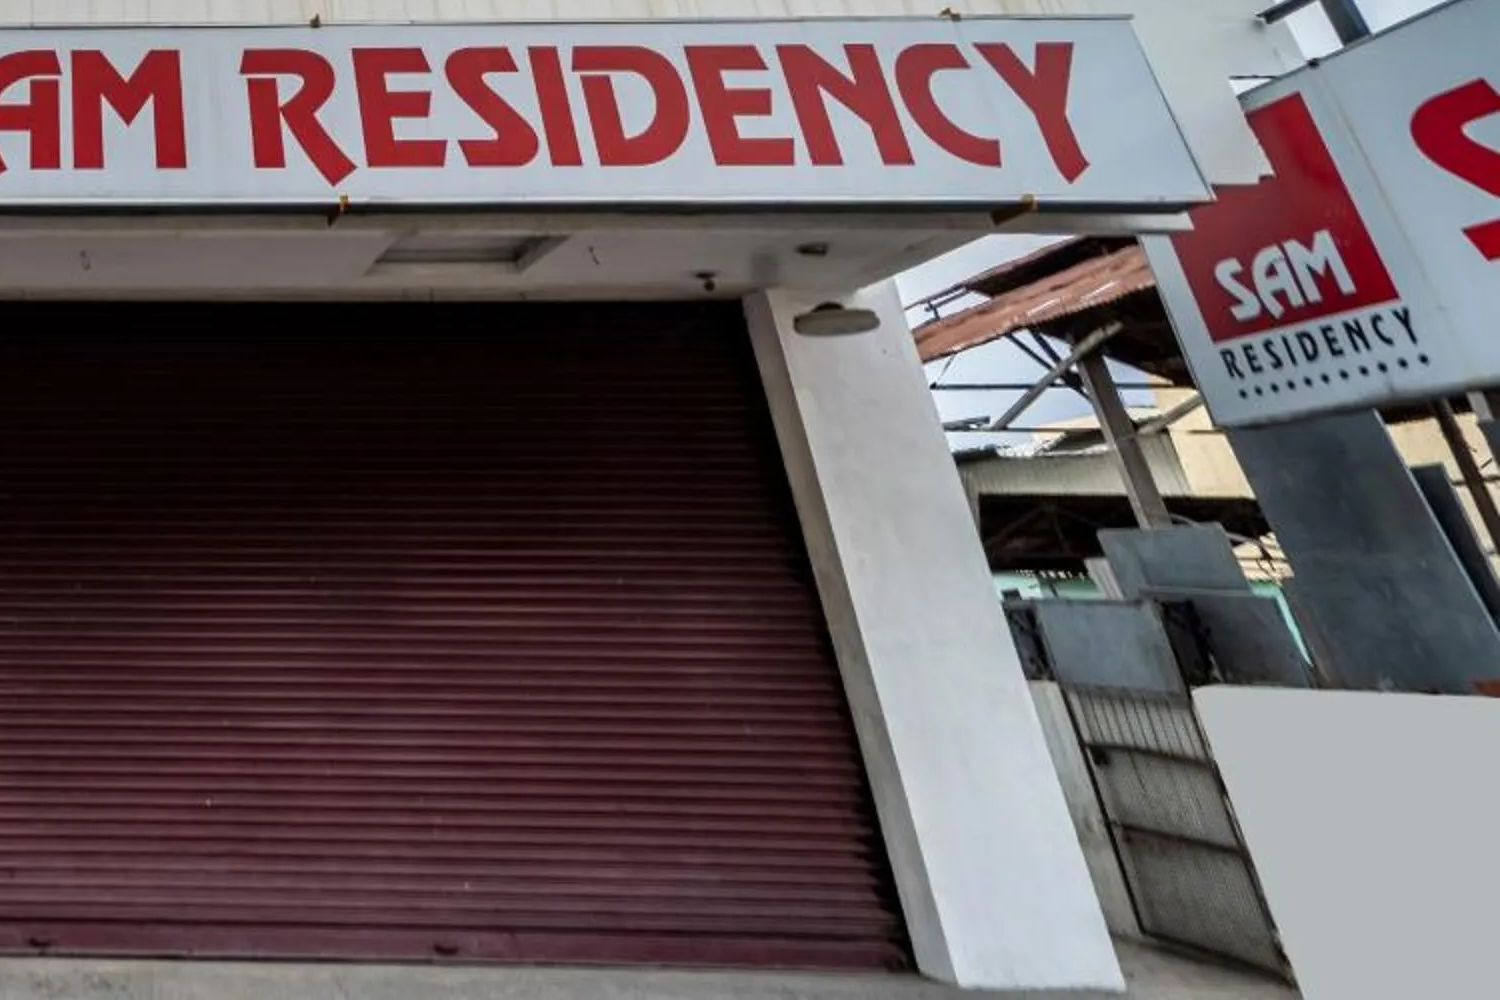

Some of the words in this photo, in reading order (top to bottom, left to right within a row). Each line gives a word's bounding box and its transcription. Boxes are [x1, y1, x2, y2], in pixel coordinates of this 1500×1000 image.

[238, 42, 1090, 187] RESIDENCY
[1214, 229, 1357, 322] SAM
[1219, 306, 1420, 380] RESIDENCY
